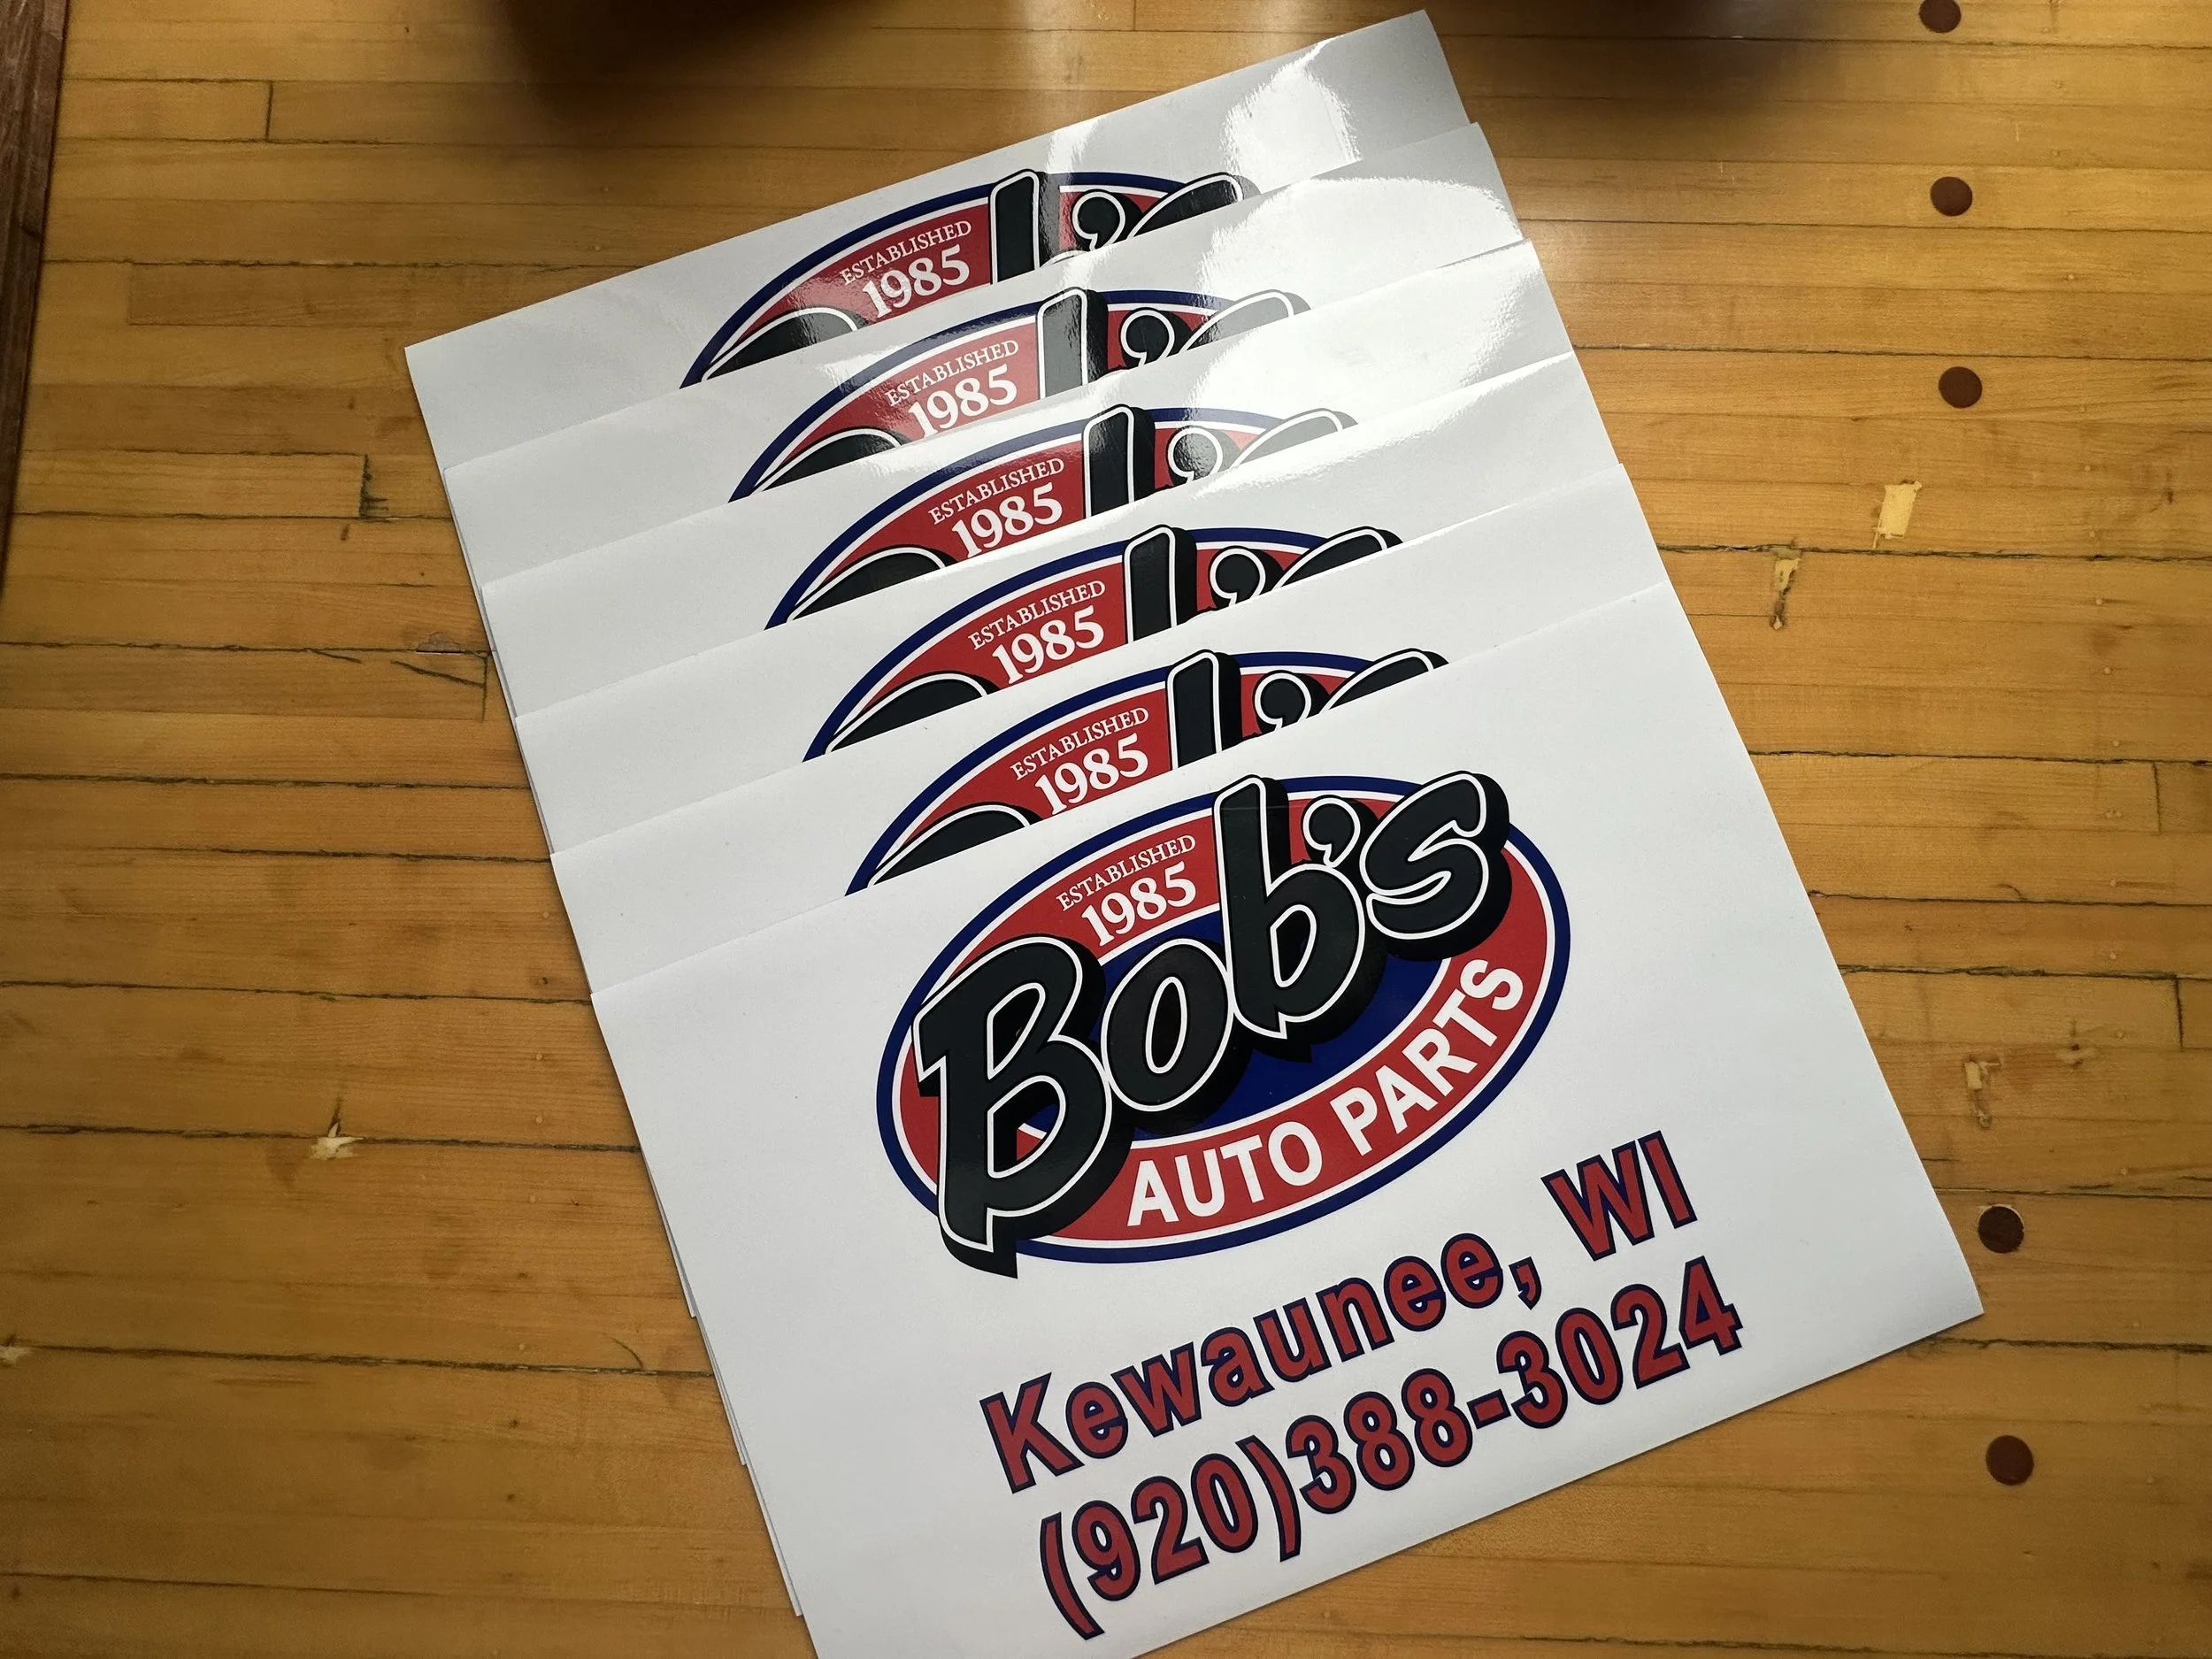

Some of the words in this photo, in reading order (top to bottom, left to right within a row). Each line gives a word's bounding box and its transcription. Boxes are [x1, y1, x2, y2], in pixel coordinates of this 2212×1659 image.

[840, 220, 972, 285] ESTABLISHED
[862, 245, 970, 319] 1985
[885, 339, 1019, 407] ESTABLISHED
[908, 364, 1018, 439] 1985
[928, 457, 1065, 526] ESTABLISHED
[952, 483, 1063, 559] 1985
[968, 580, 1106, 650] ESTABLISHED
[991, 605, 1104, 686] 1985
[1010, 706, 1149, 781] ESTABLISHED
[1034, 733, 1148, 815] 1985
[1056, 833, 1195, 912] ESTABLISHED
[1079, 861, 1195, 947] 1985
[913, 770, 1506, 1272] Bob's
[1126, 1121, 1324, 1226] AUTO
[1328, 958, 1525, 1156] PARTS
[979, 1233, 1541, 1494] Kewaunee,
[1541, 1130, 1697, 1260] WI
[1039, 1256, 1743, 1640] (920)388-3024
